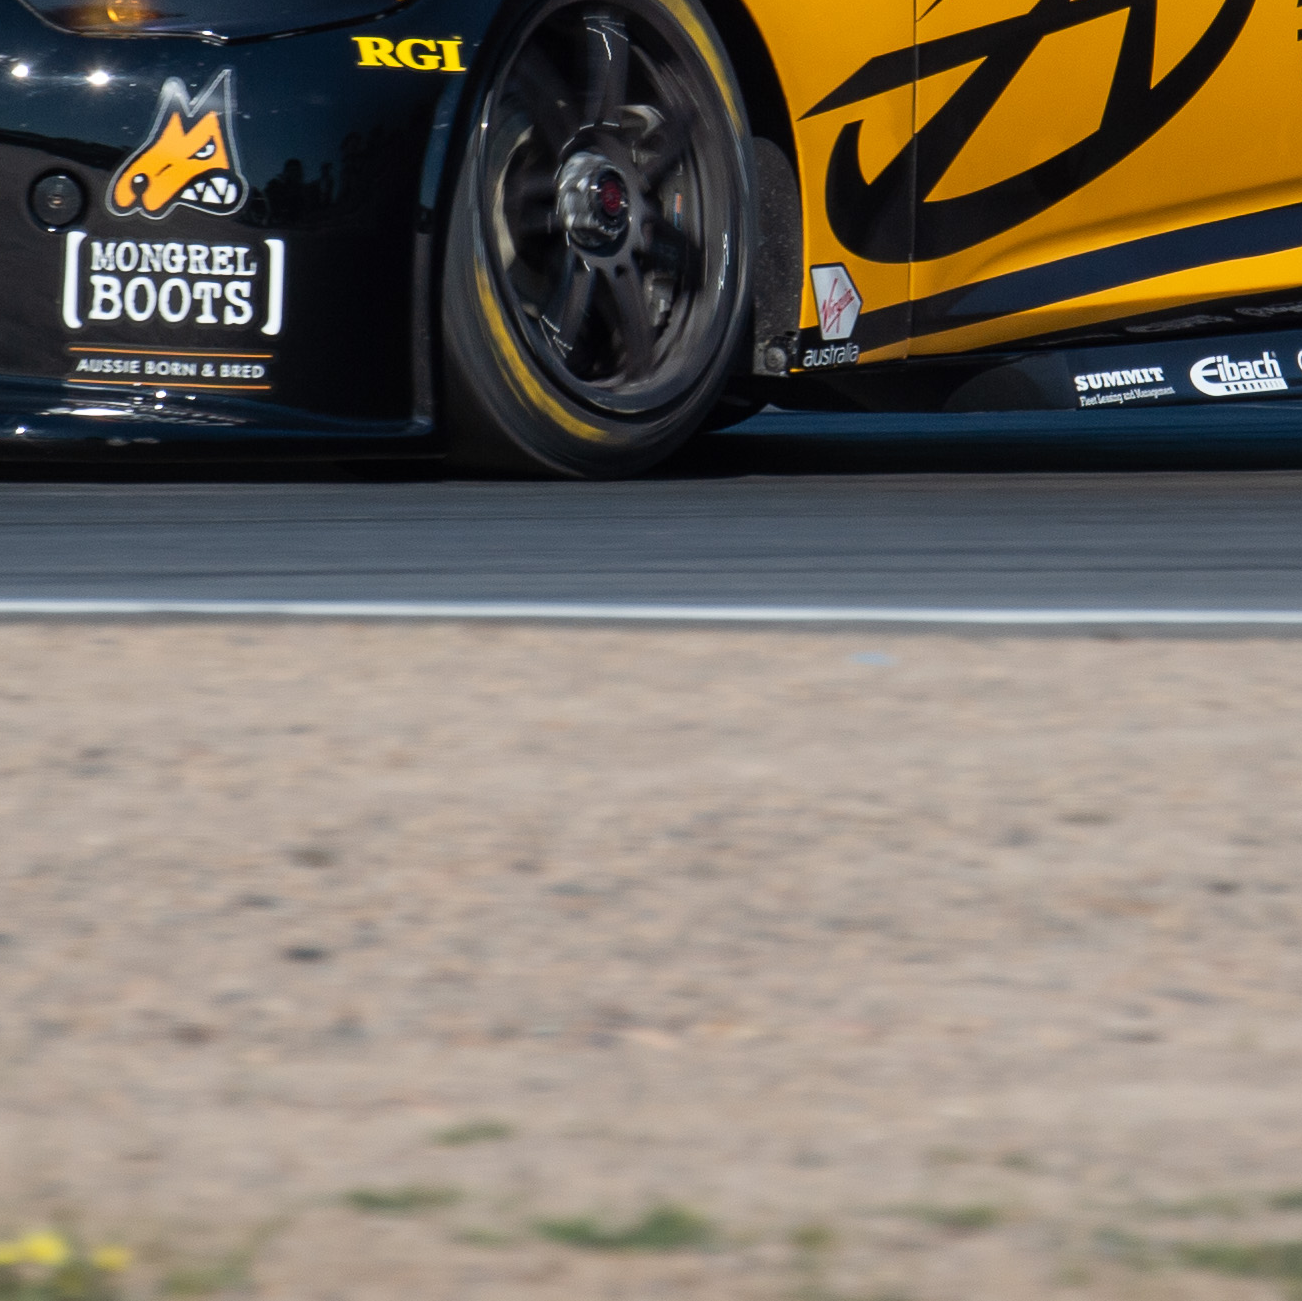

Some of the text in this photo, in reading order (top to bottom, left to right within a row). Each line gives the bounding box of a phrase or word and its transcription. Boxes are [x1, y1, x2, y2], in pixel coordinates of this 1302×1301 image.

[351, 36, 467, 72] RGI
[90, 241, 257, 276] MONGREL
[88, 275, 253, 325] BOOTS
[75, 358, 265, 379] AUSSIE BORN & BRED
[803, 343, 859, 368] australia
[1074, 367, 1165, 391] SUMMIT
[1190, 352, 1283, 396] Eibach
